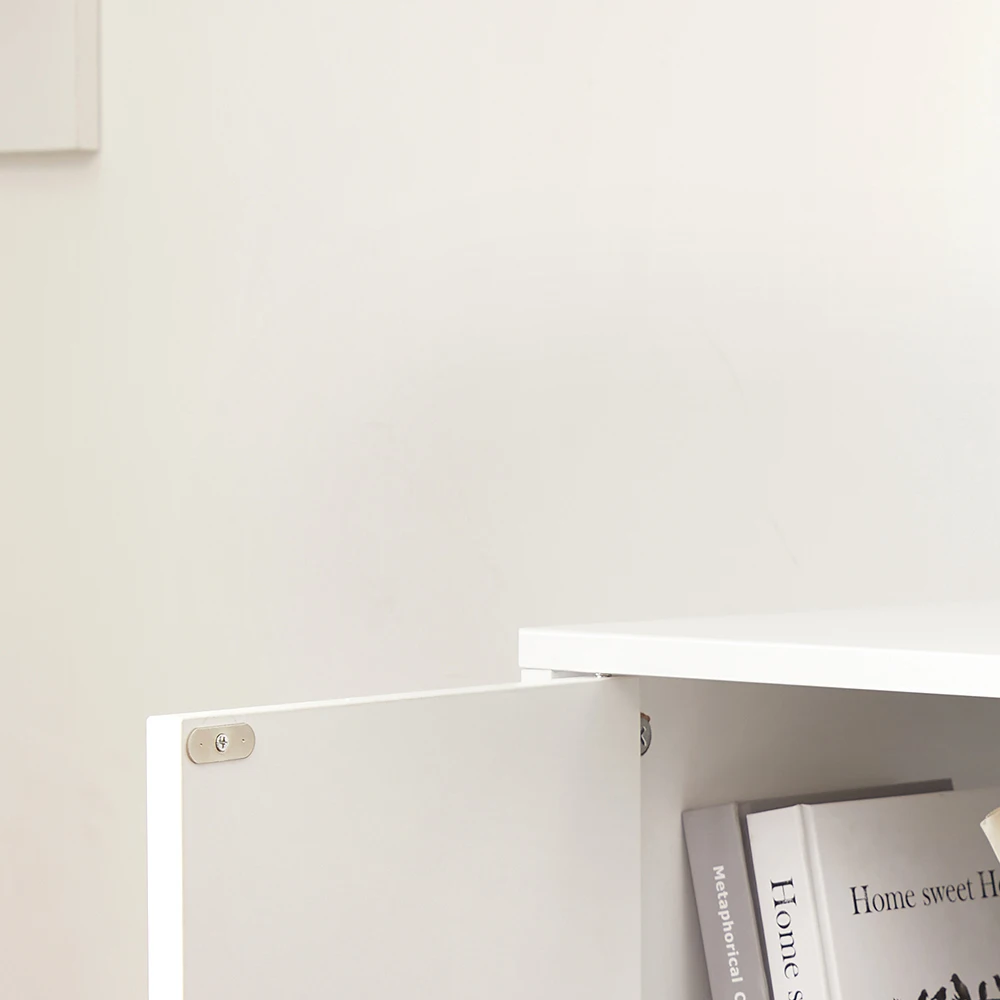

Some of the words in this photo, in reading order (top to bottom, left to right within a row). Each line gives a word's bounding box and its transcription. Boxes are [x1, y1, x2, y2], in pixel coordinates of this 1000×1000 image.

[712, 864, 744, 984] Metaphorical
[770, 876, 799, 979] Home
[849, 884, 917, 915] Home
[922, 877, 975, 907] sweet
